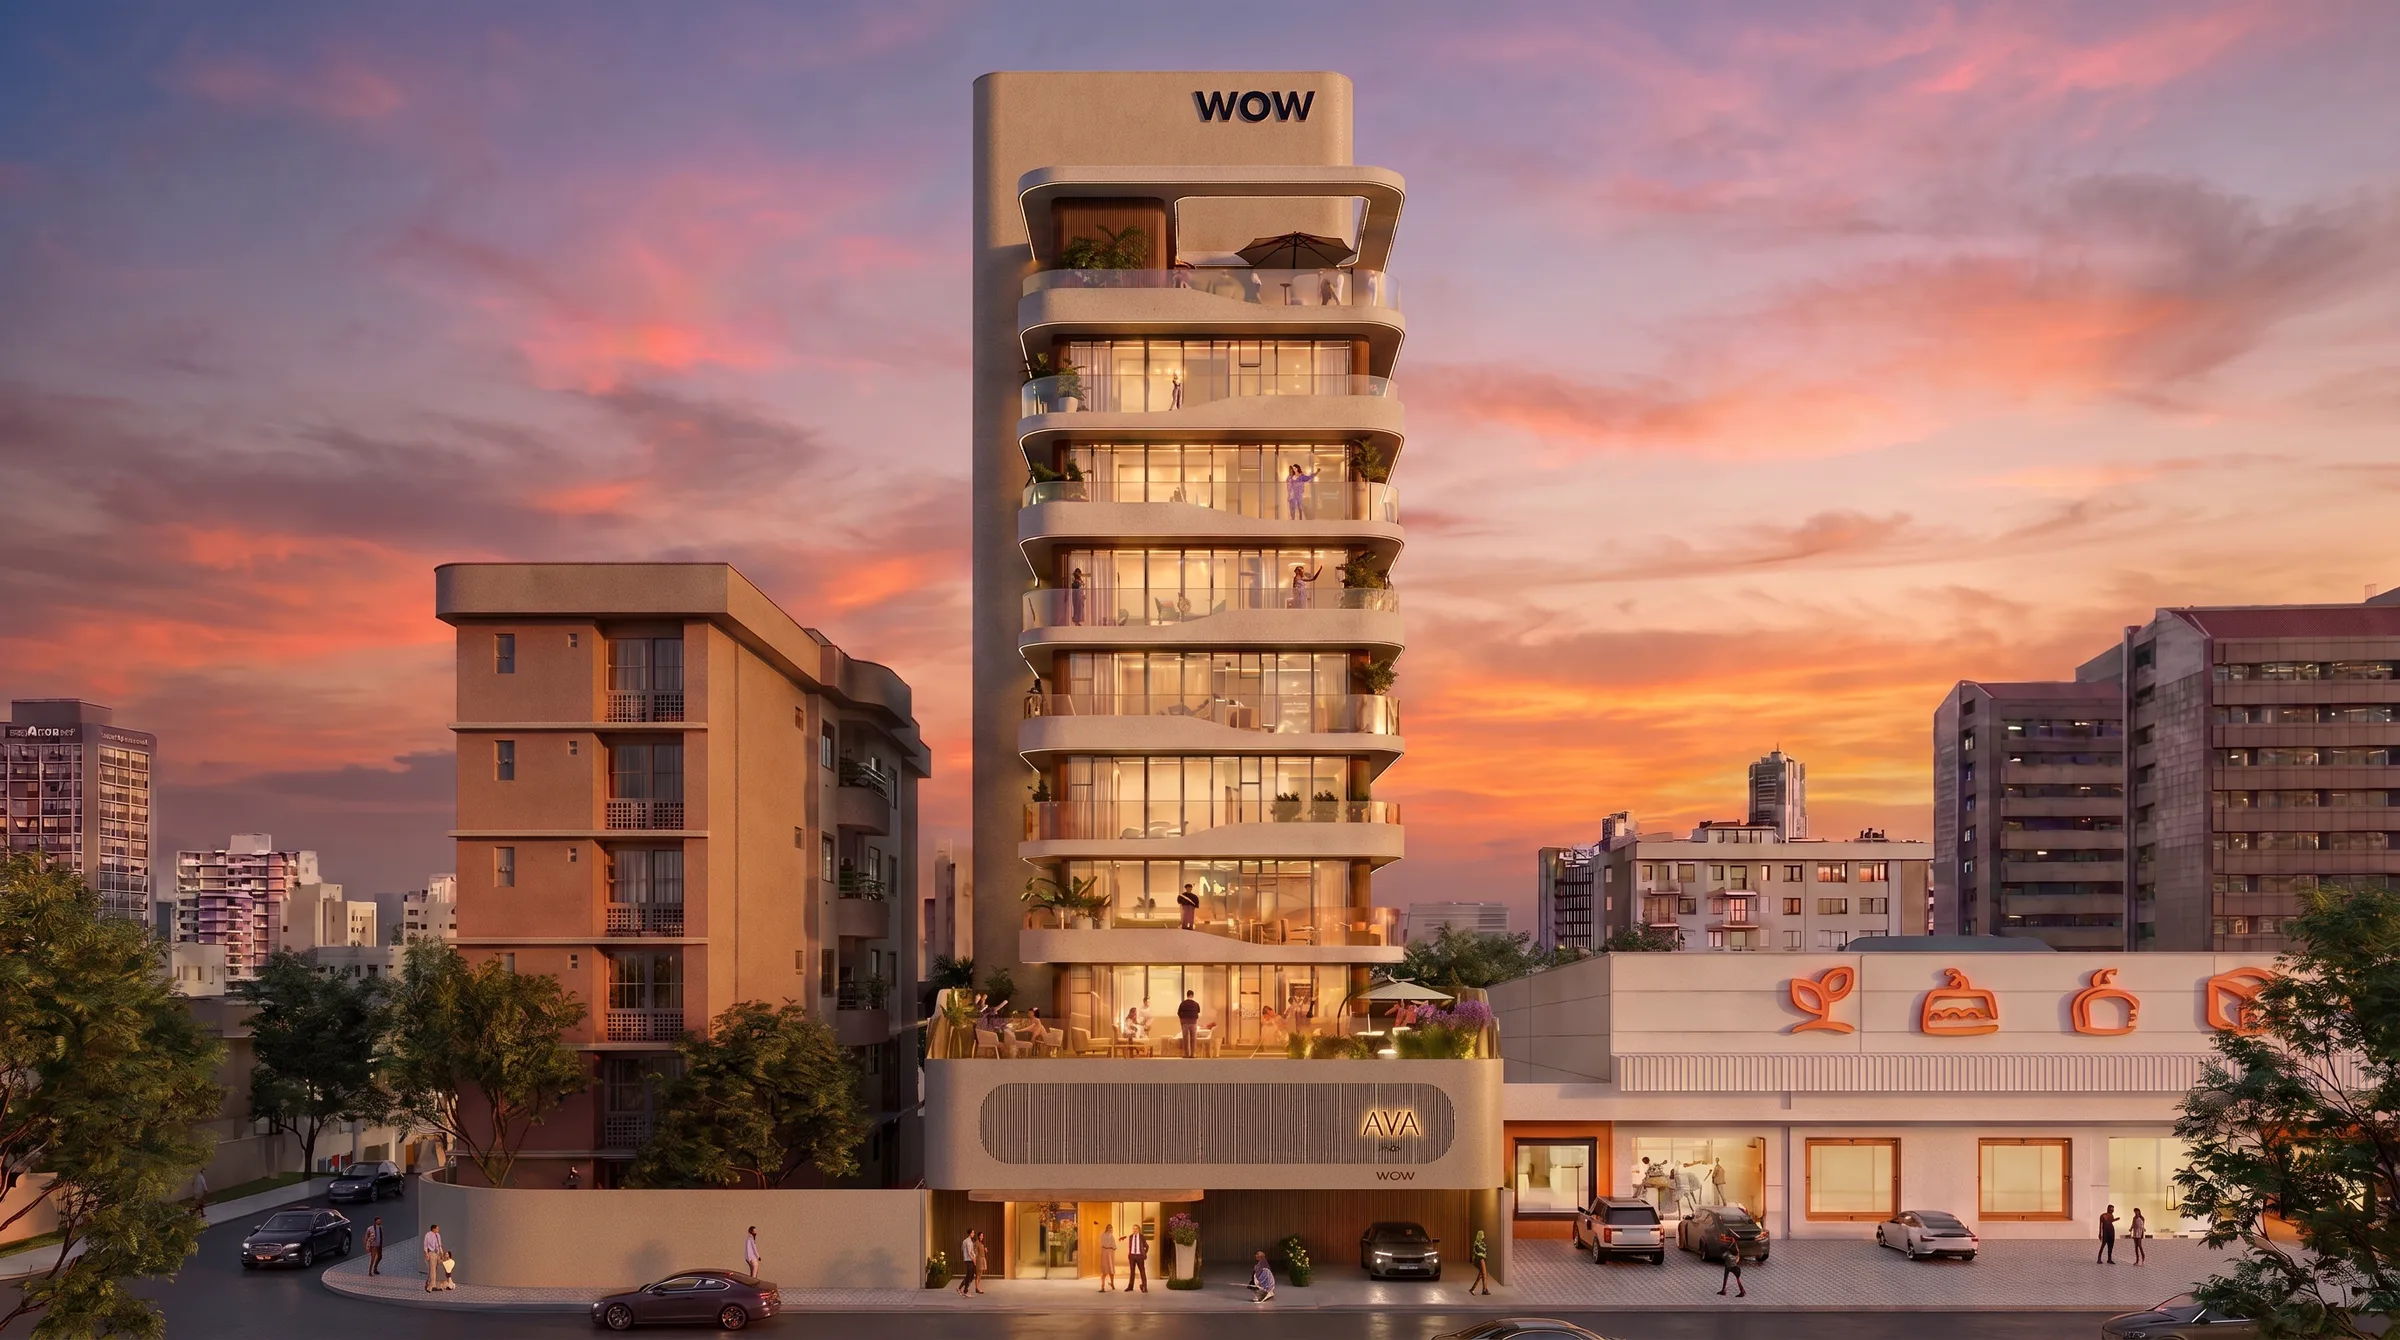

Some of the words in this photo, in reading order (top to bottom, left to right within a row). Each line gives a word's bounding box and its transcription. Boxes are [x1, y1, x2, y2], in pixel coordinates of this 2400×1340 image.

[1193, 90, 1316, 123] WOW
[1362, 1110, 1420, 1137] AVA
[1375, 1171, 1416, 1181] WOW
